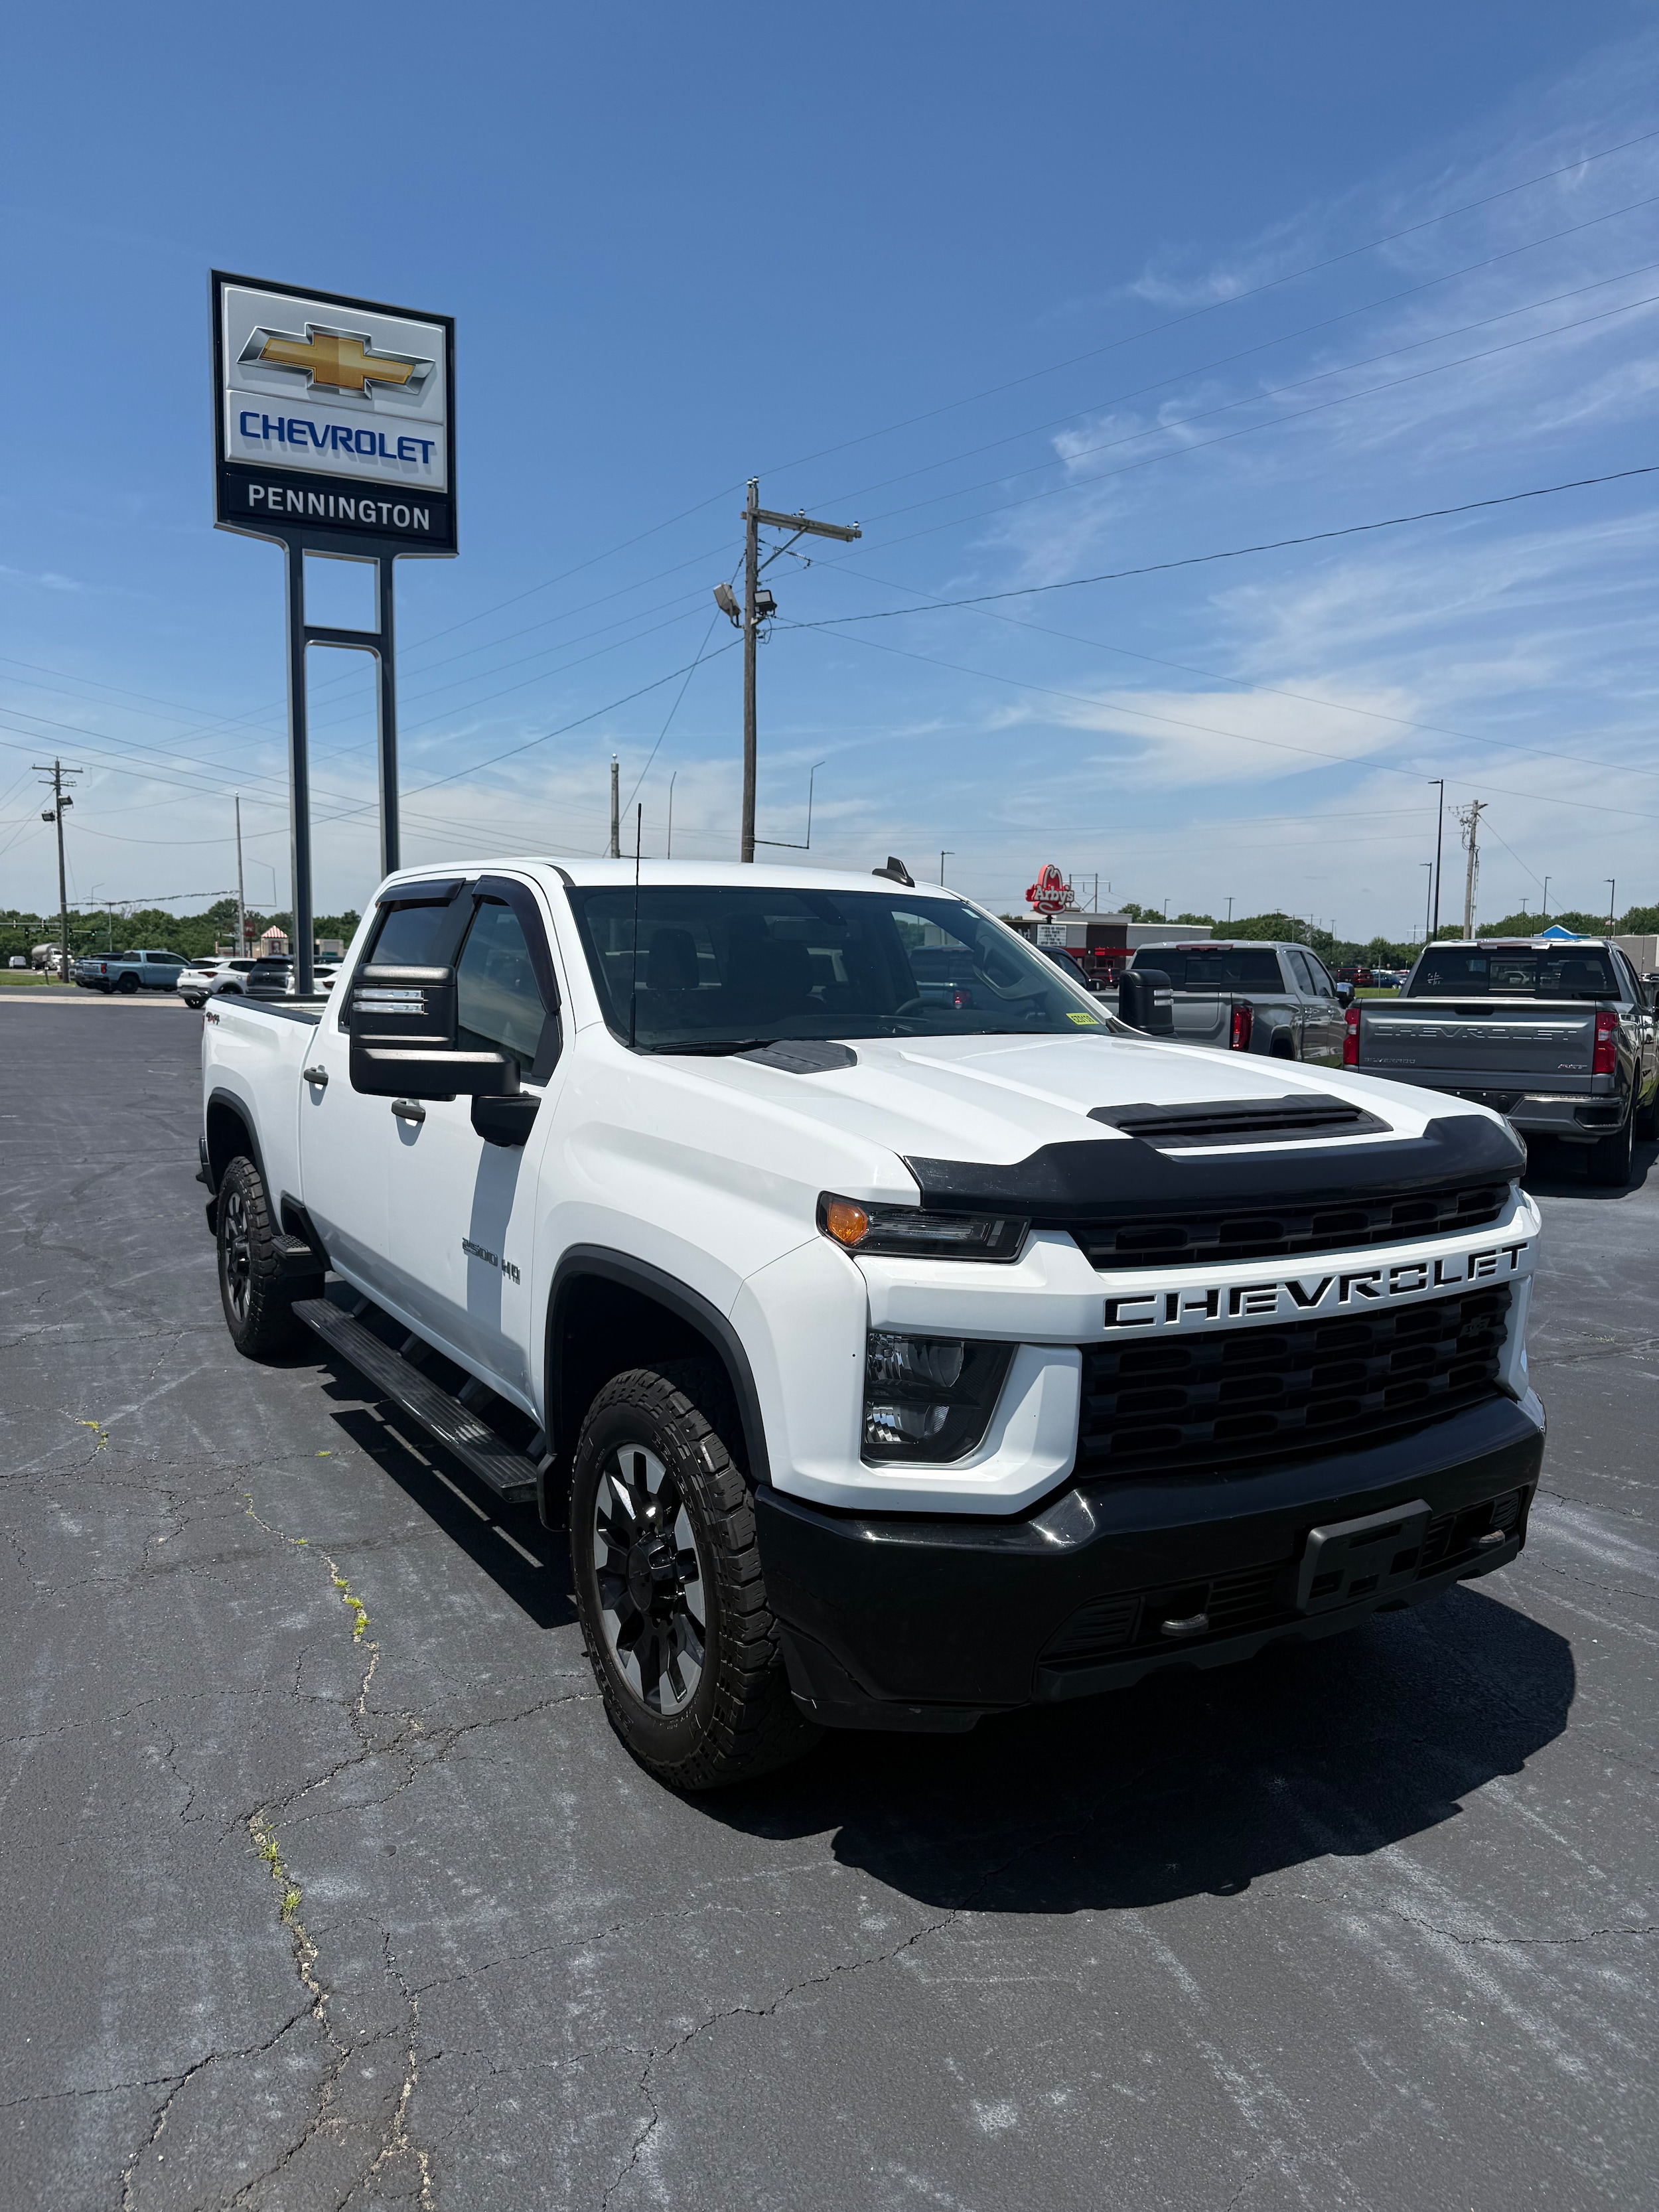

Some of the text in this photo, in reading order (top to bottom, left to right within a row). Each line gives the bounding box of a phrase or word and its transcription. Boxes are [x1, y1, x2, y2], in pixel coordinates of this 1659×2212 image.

[240, 410, 435, 464] CHEVROLET
[248, 484, 430, 530] PENNINGTON
[1034, 885, 1074, 905] Arby's
[1374, 1025, 1577, 1041] CHEVROLET
[462, 1237, 520, 1280] 2500 HD
[1104, 1243, 1529, 1330] CHEVROLET
